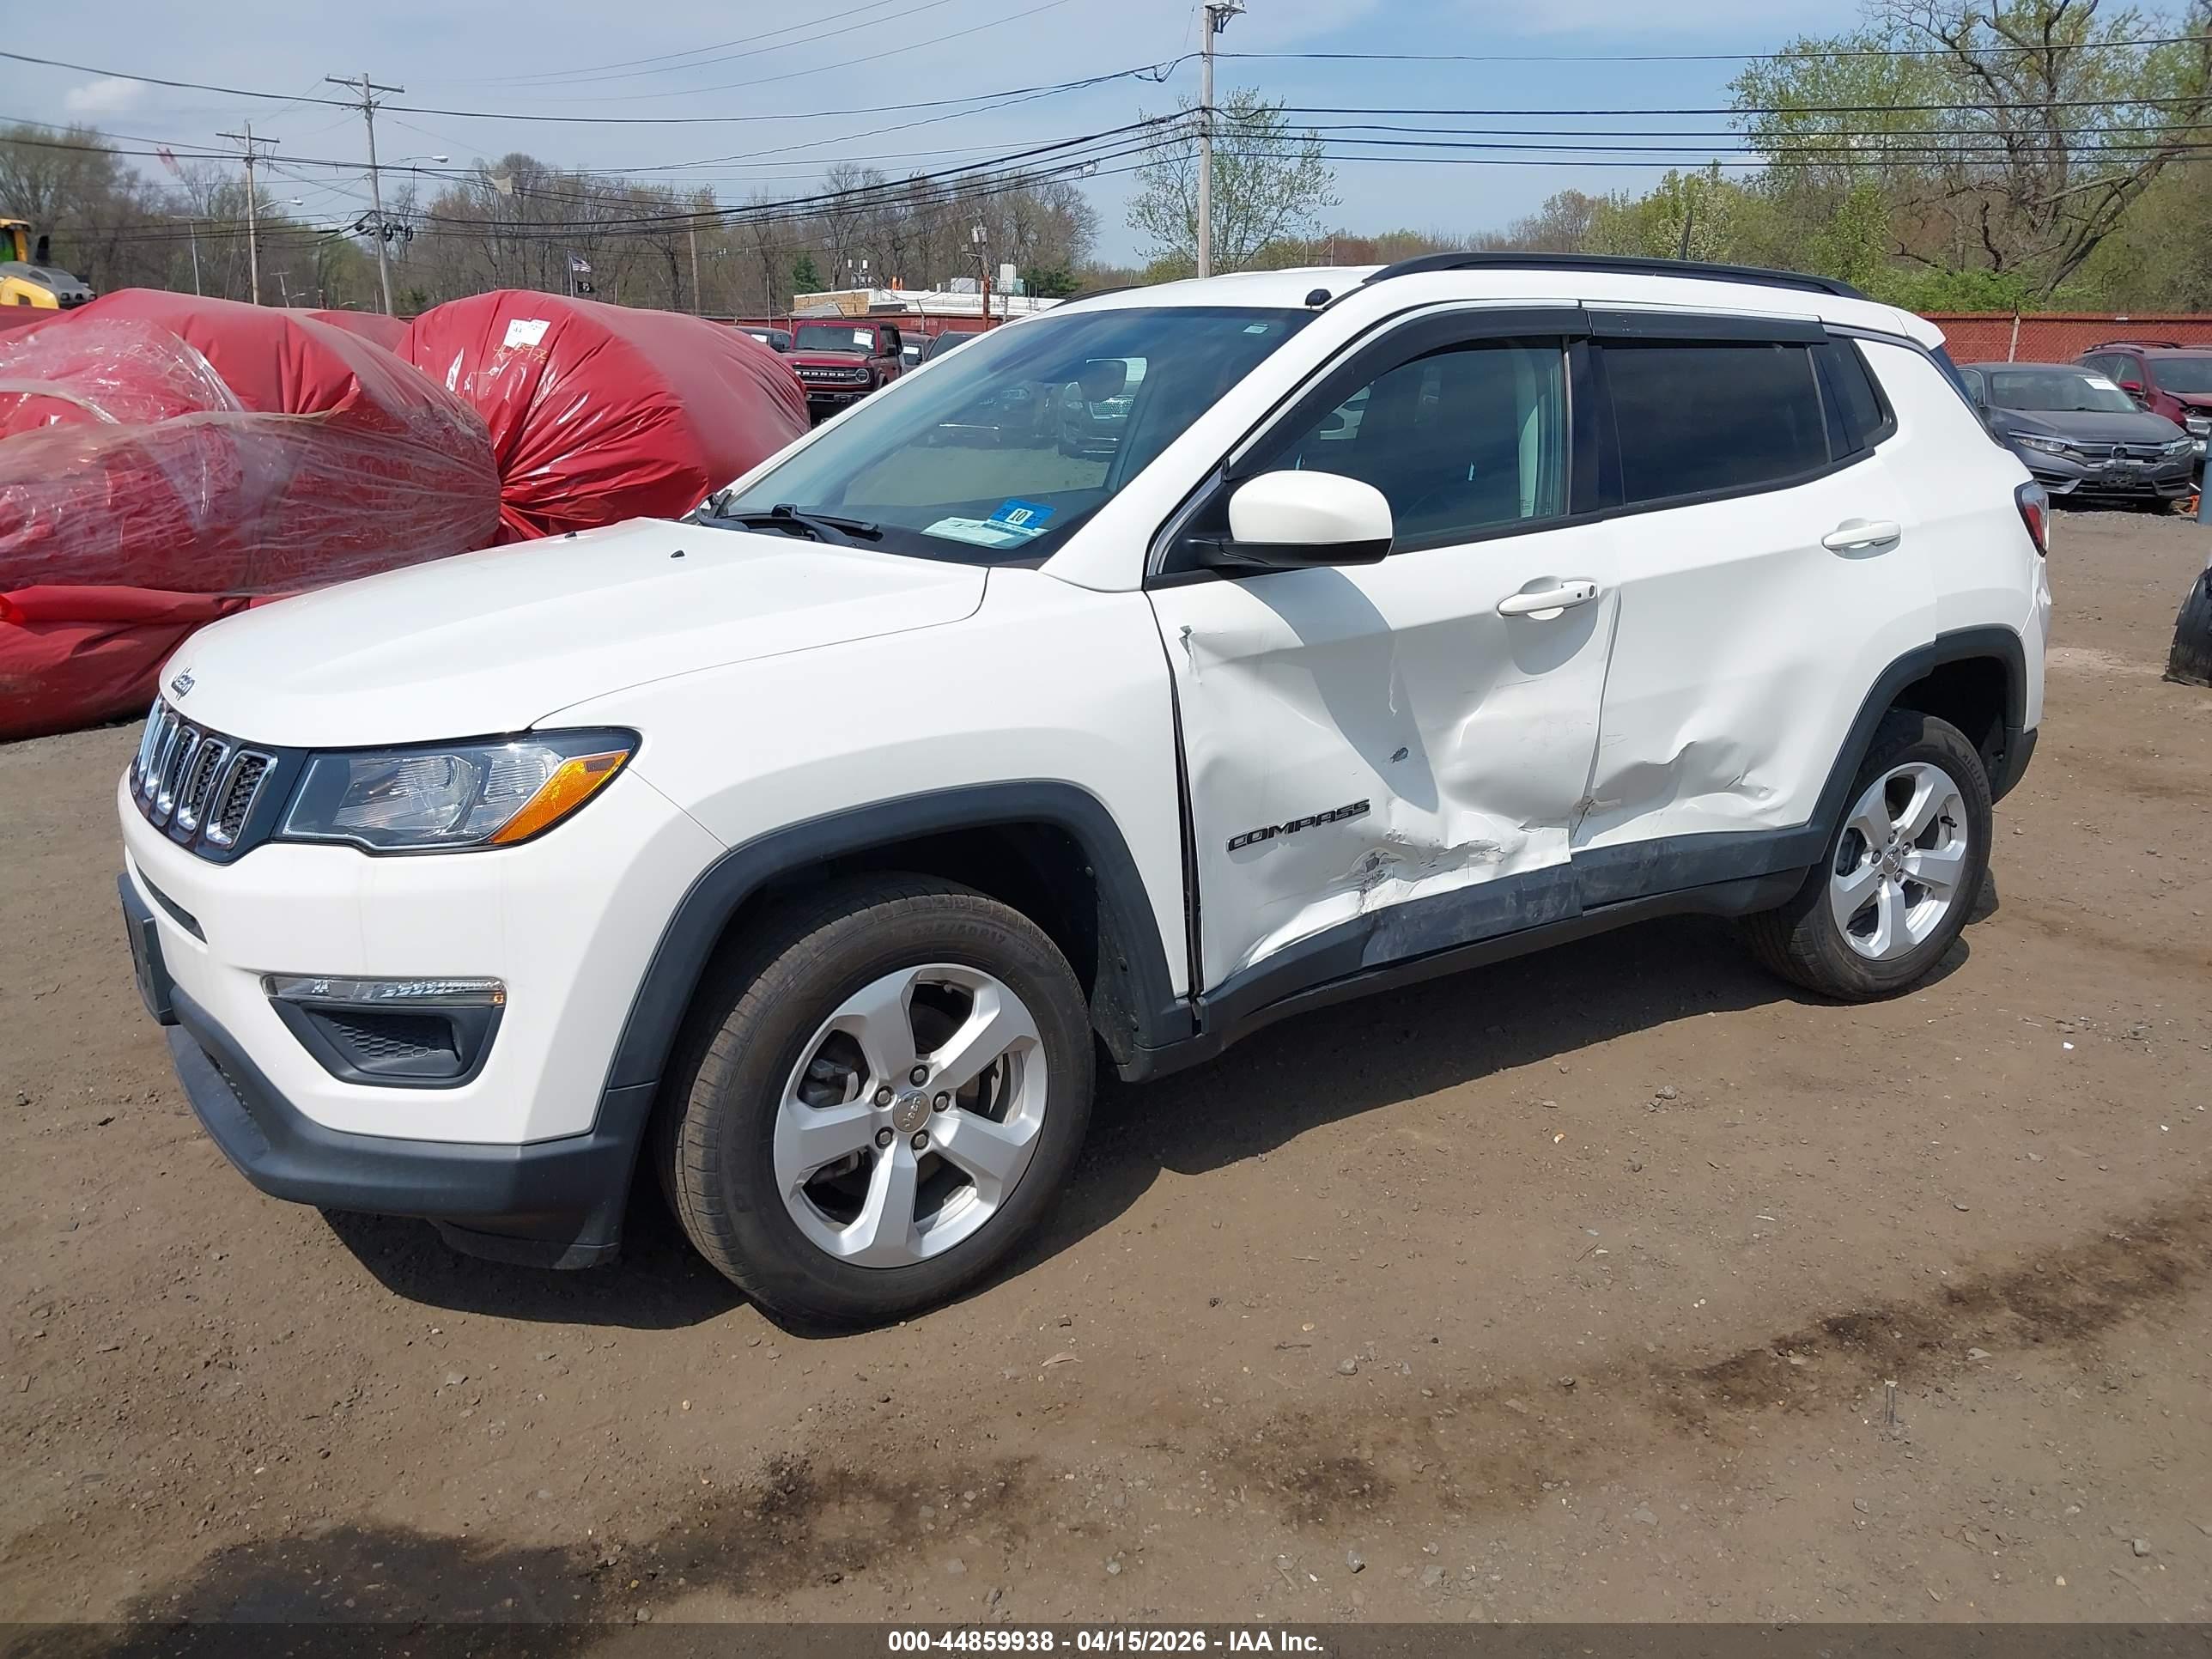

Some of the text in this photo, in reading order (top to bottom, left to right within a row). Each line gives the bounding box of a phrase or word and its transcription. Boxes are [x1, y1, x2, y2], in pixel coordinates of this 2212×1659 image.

[1009, 509, 1029, 522] 10
[1226, 798, 1371, 853] COMPASS
[902, 1096, 921, 1128] Jeep
